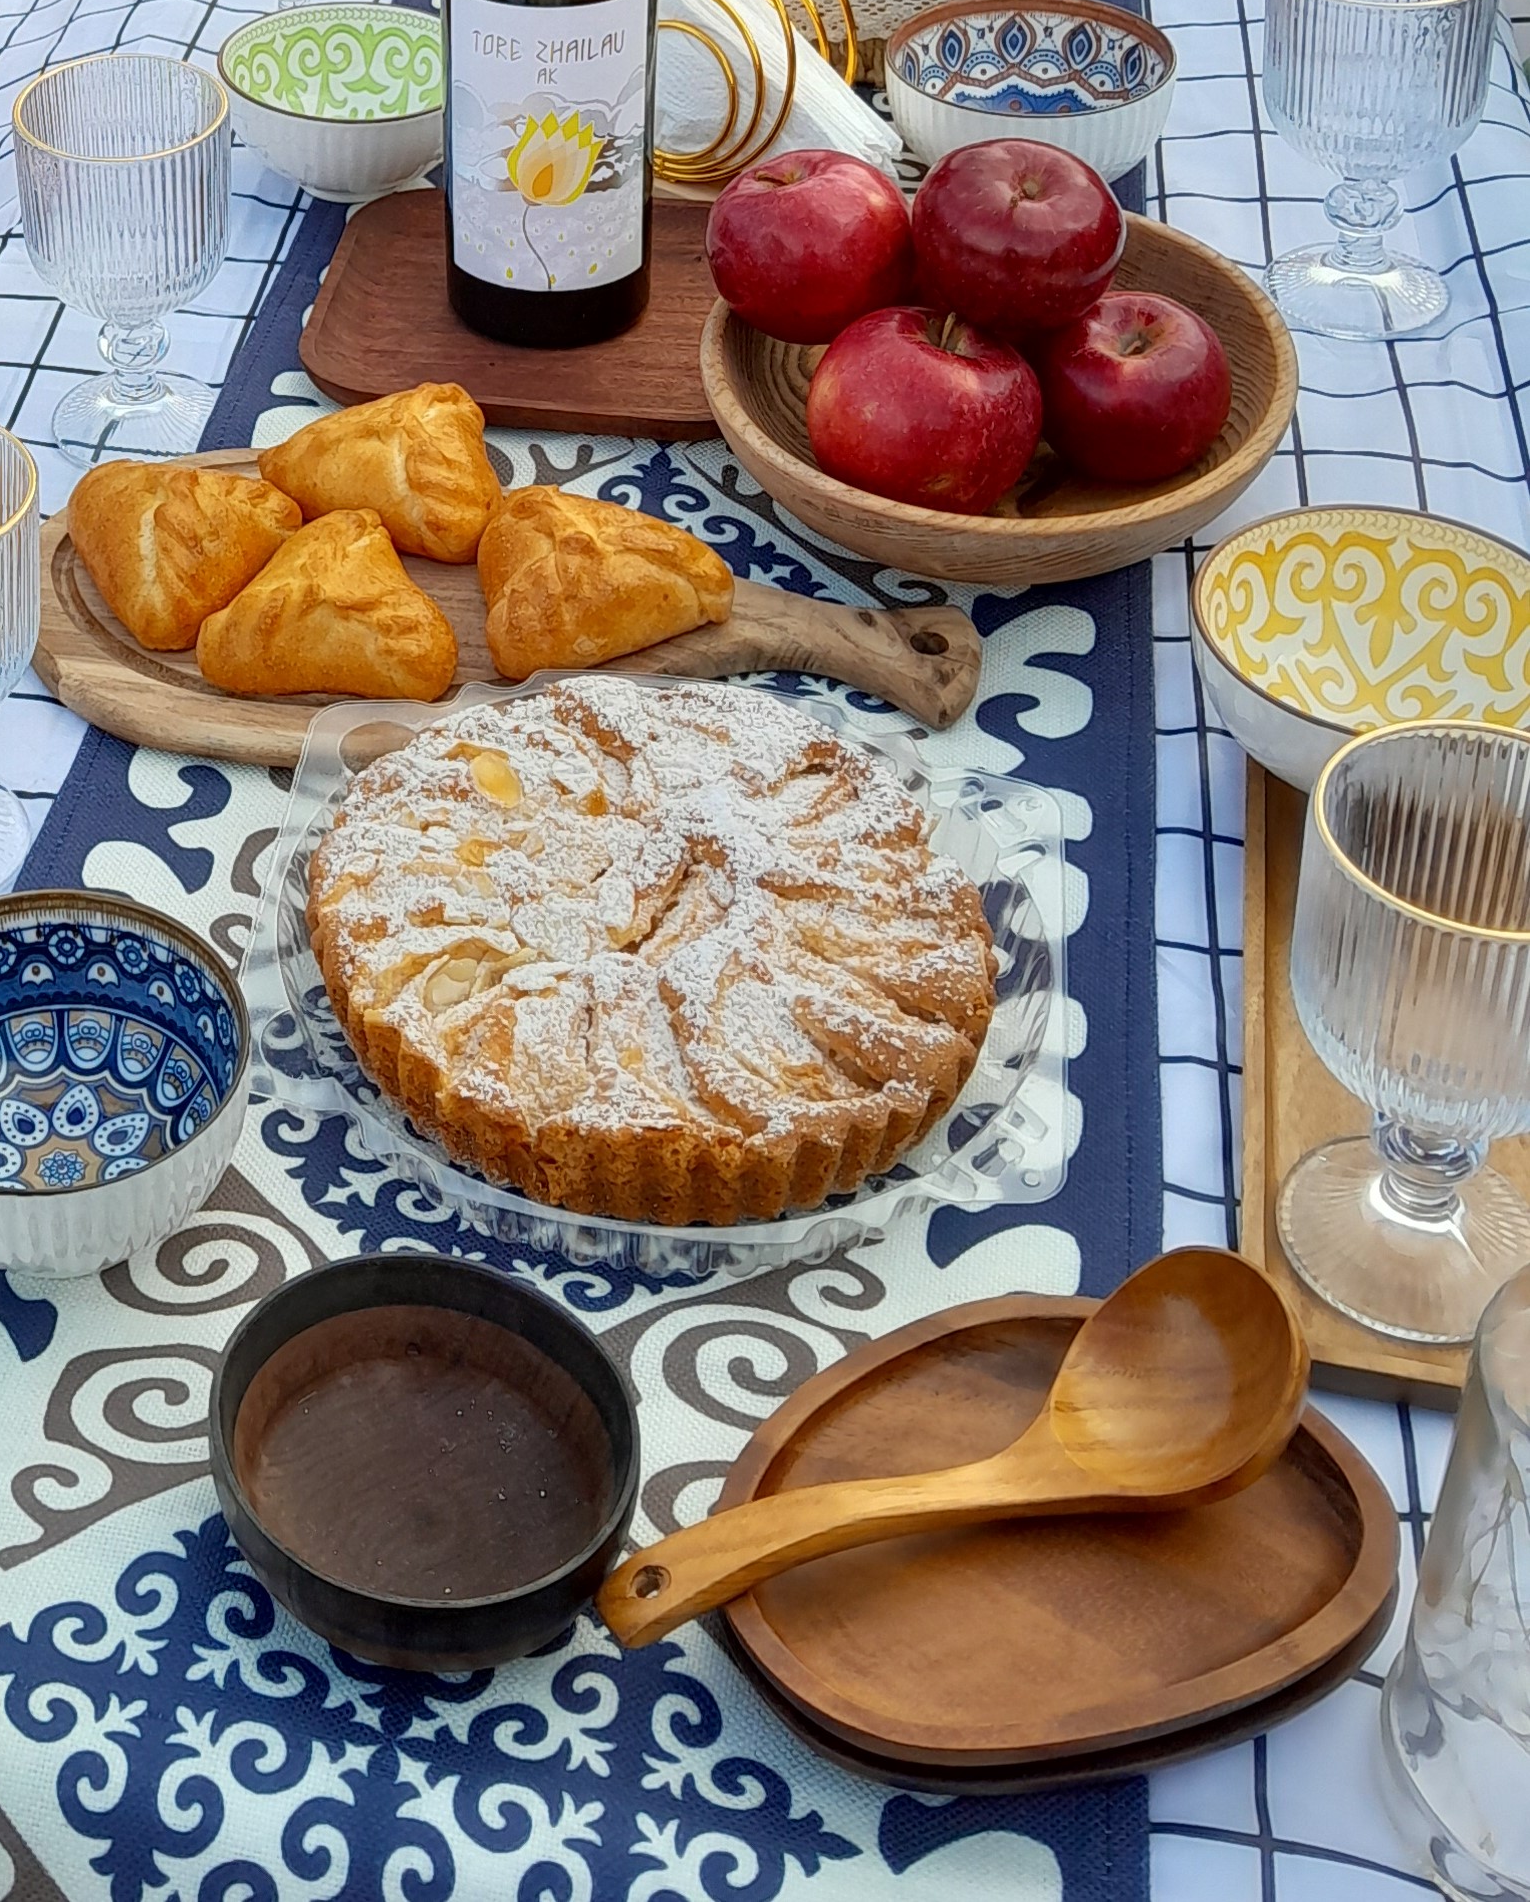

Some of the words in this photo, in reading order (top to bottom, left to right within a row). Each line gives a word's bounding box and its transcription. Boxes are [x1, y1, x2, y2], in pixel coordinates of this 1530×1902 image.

[472, 30, 522, 61] TORE
[535, 29, 625, 64] ZHAILAU
[536, 67, 558, 84] AK
